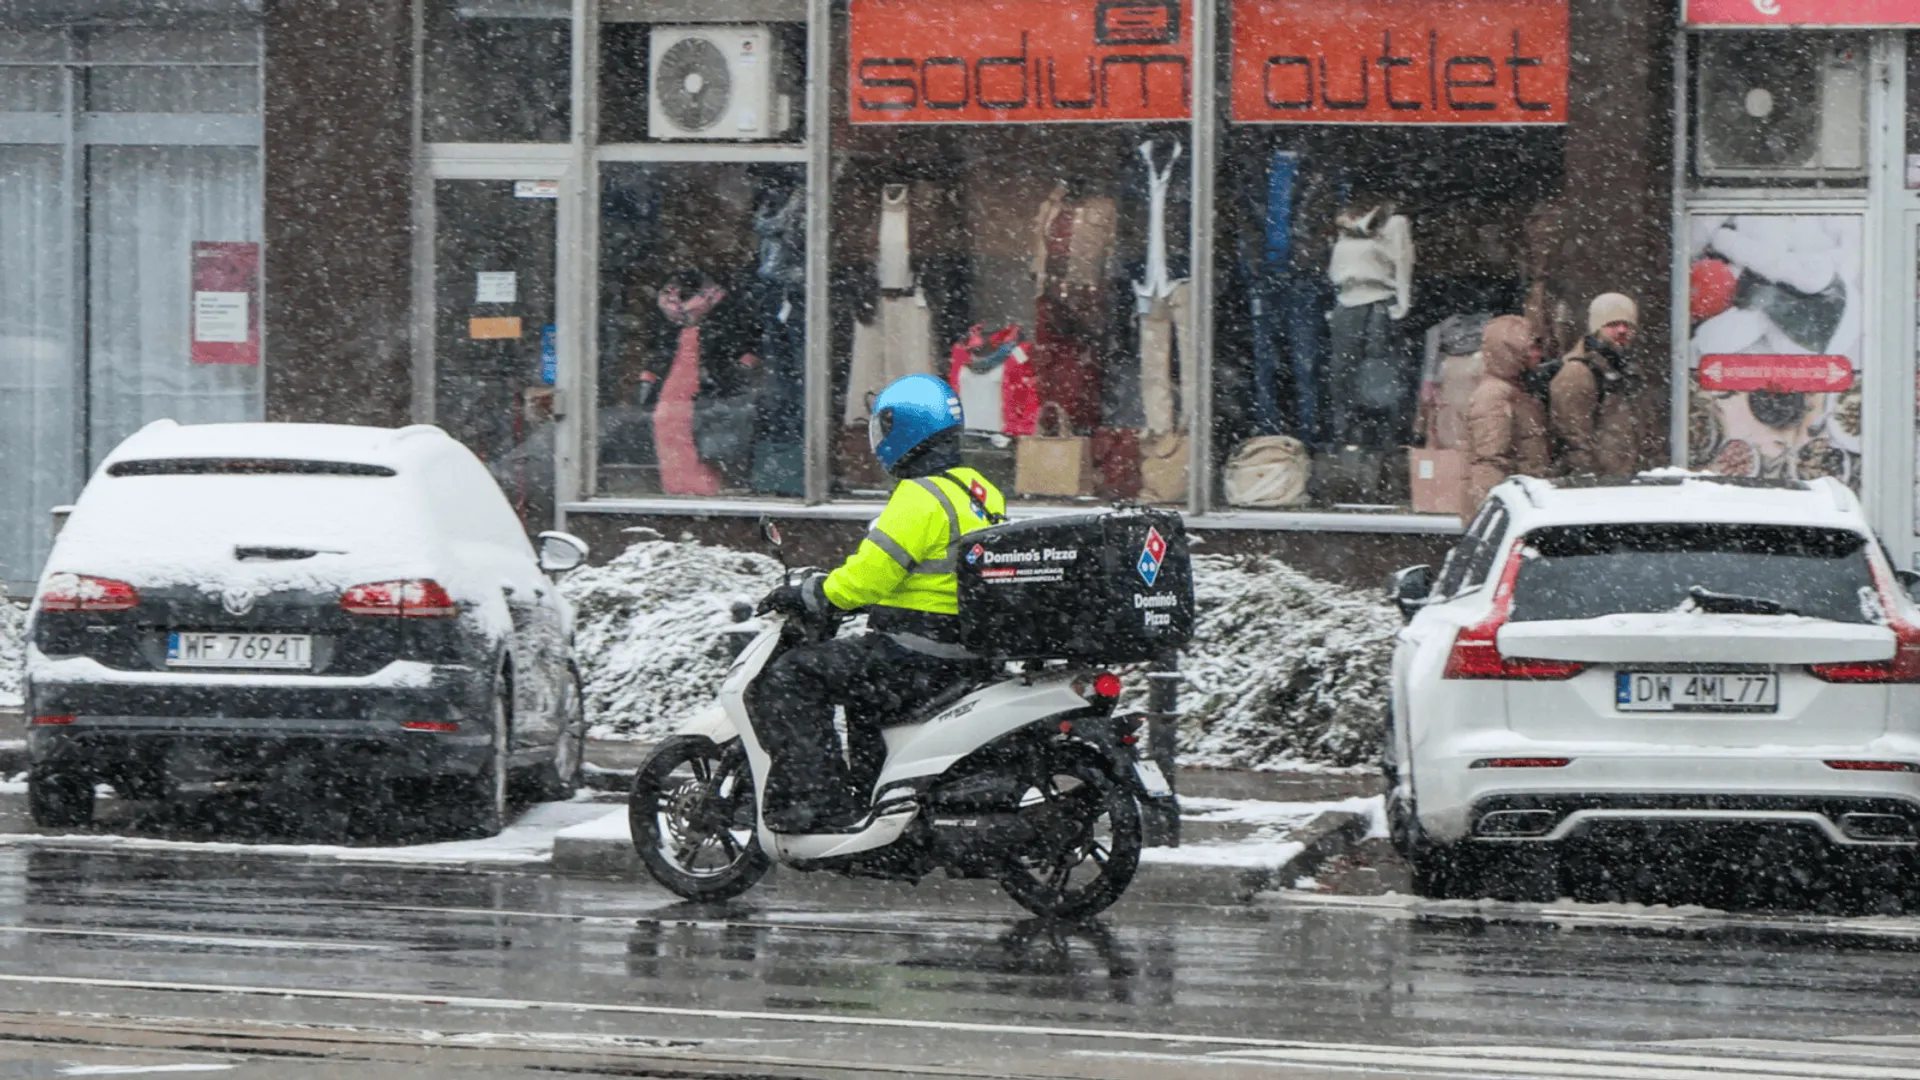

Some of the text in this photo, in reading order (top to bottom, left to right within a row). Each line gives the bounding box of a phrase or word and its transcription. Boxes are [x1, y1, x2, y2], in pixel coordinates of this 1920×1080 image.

[858, 30, 1189, 110] sodium
[1263, 29, 1551, 110] outlet
[983, 547, 1078, 564] Domino's Pizza
[1134, 590, 1177, 608] Domino's
[1144, 610, 1170, 626] Pizza
[186, 635, 305, 661] WF 7694T
[1636, 675, 1770, 703] DW 4ML77
